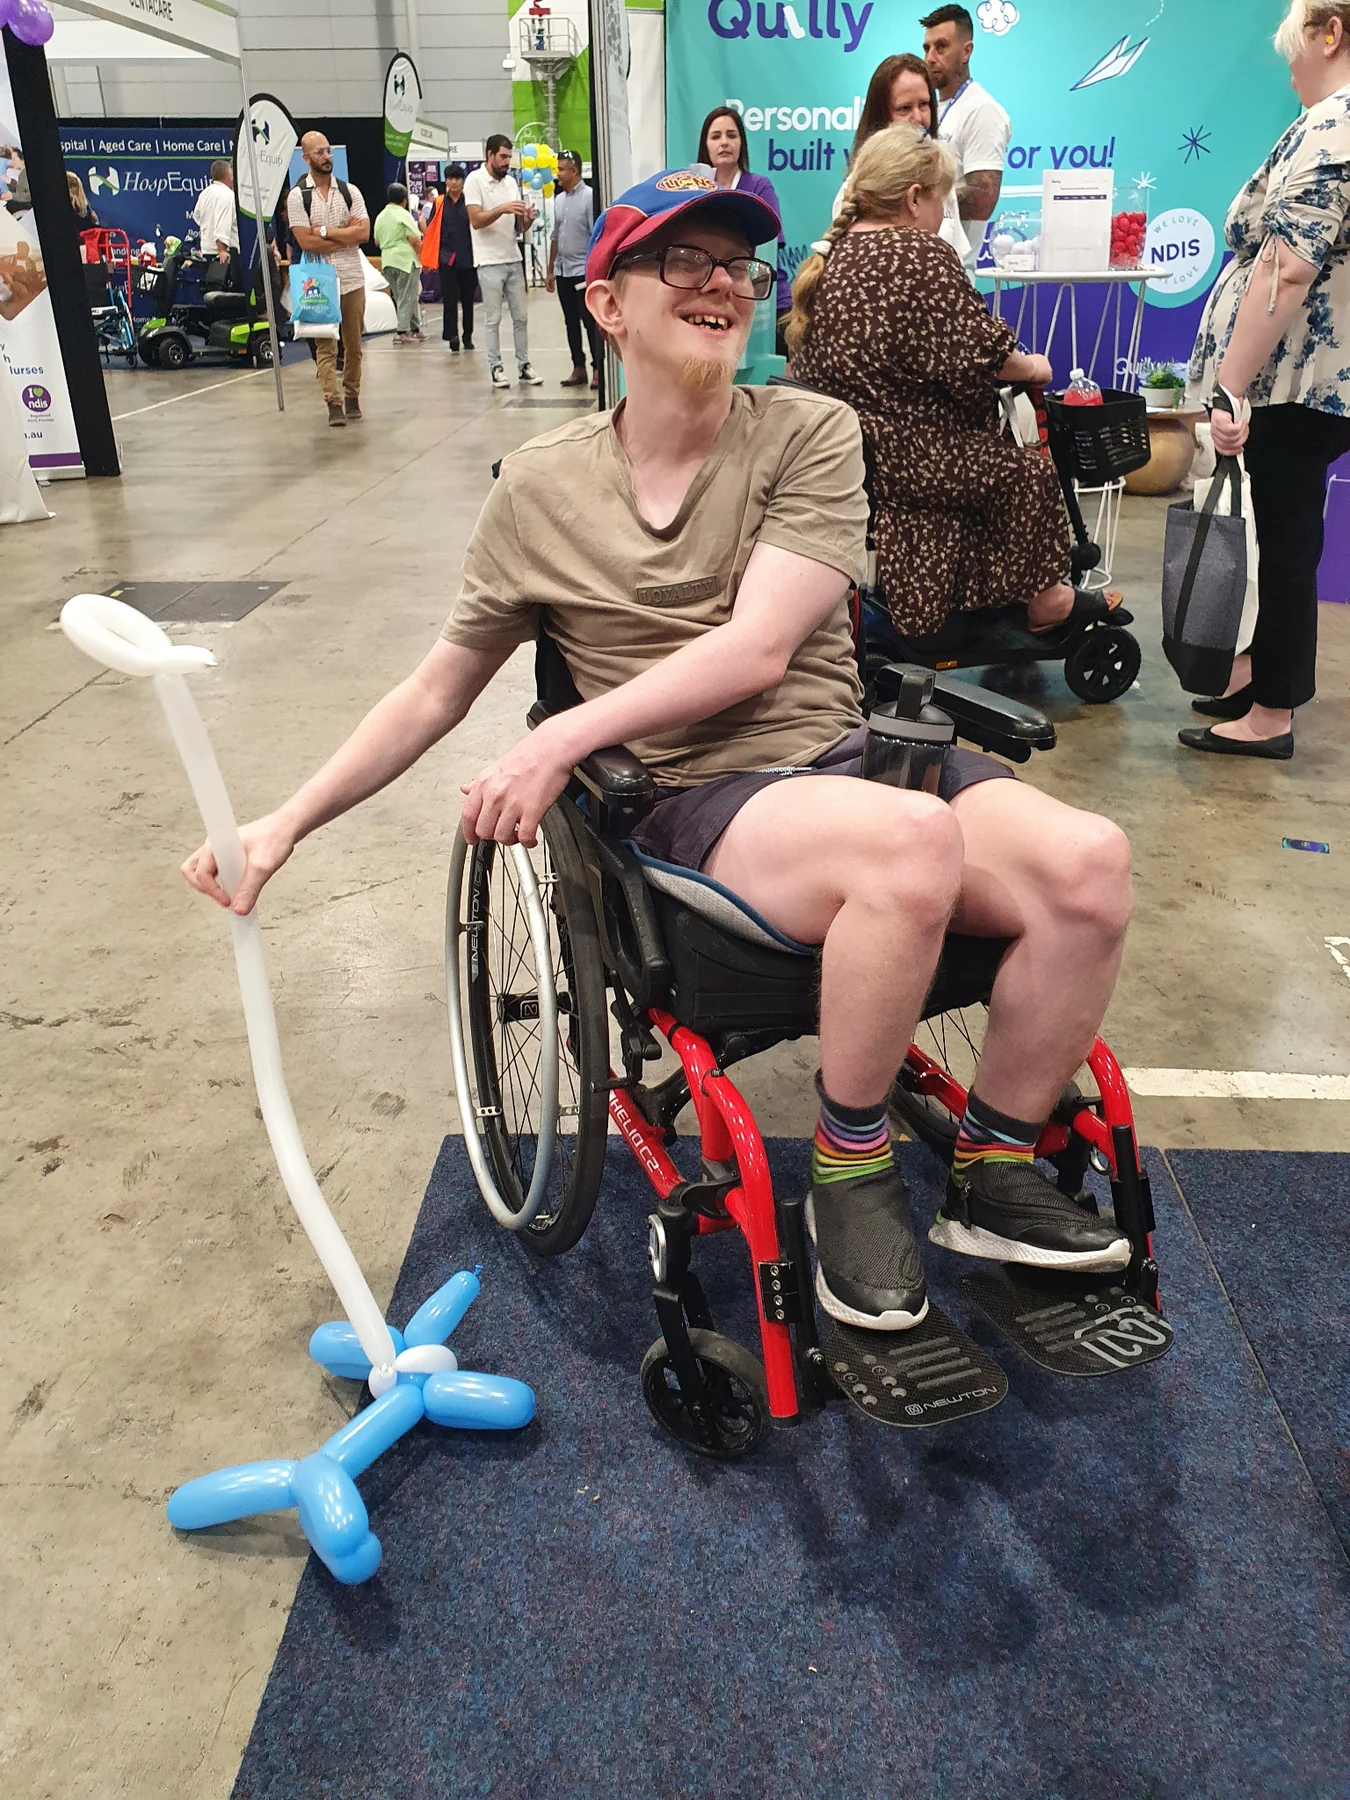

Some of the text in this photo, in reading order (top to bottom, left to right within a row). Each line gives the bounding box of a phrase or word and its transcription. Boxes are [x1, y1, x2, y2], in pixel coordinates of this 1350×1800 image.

[708, 0, 874, 52] Quilly
[99, 140, 125, 153] Aged
[127, 140, 151, 151] Care
[163, 141, 195, 151] Home
[197, 140, 221, 151] Care
[768, 138, 835, 171] built
[1005, 136, 1115, 169] or you!
[123, 171, 213, 196] HospEqui
[1153, 215, 1199, 234] WE LOVE
[1151, 238, 1200, 264] NDIS
[28, 398, 48, 409] ndis
[640, 579, 714, 603] LOYALTY
[609, 1097, 644, 1148] HELIO
[923, 1386, 998, 1410] NEWTON
